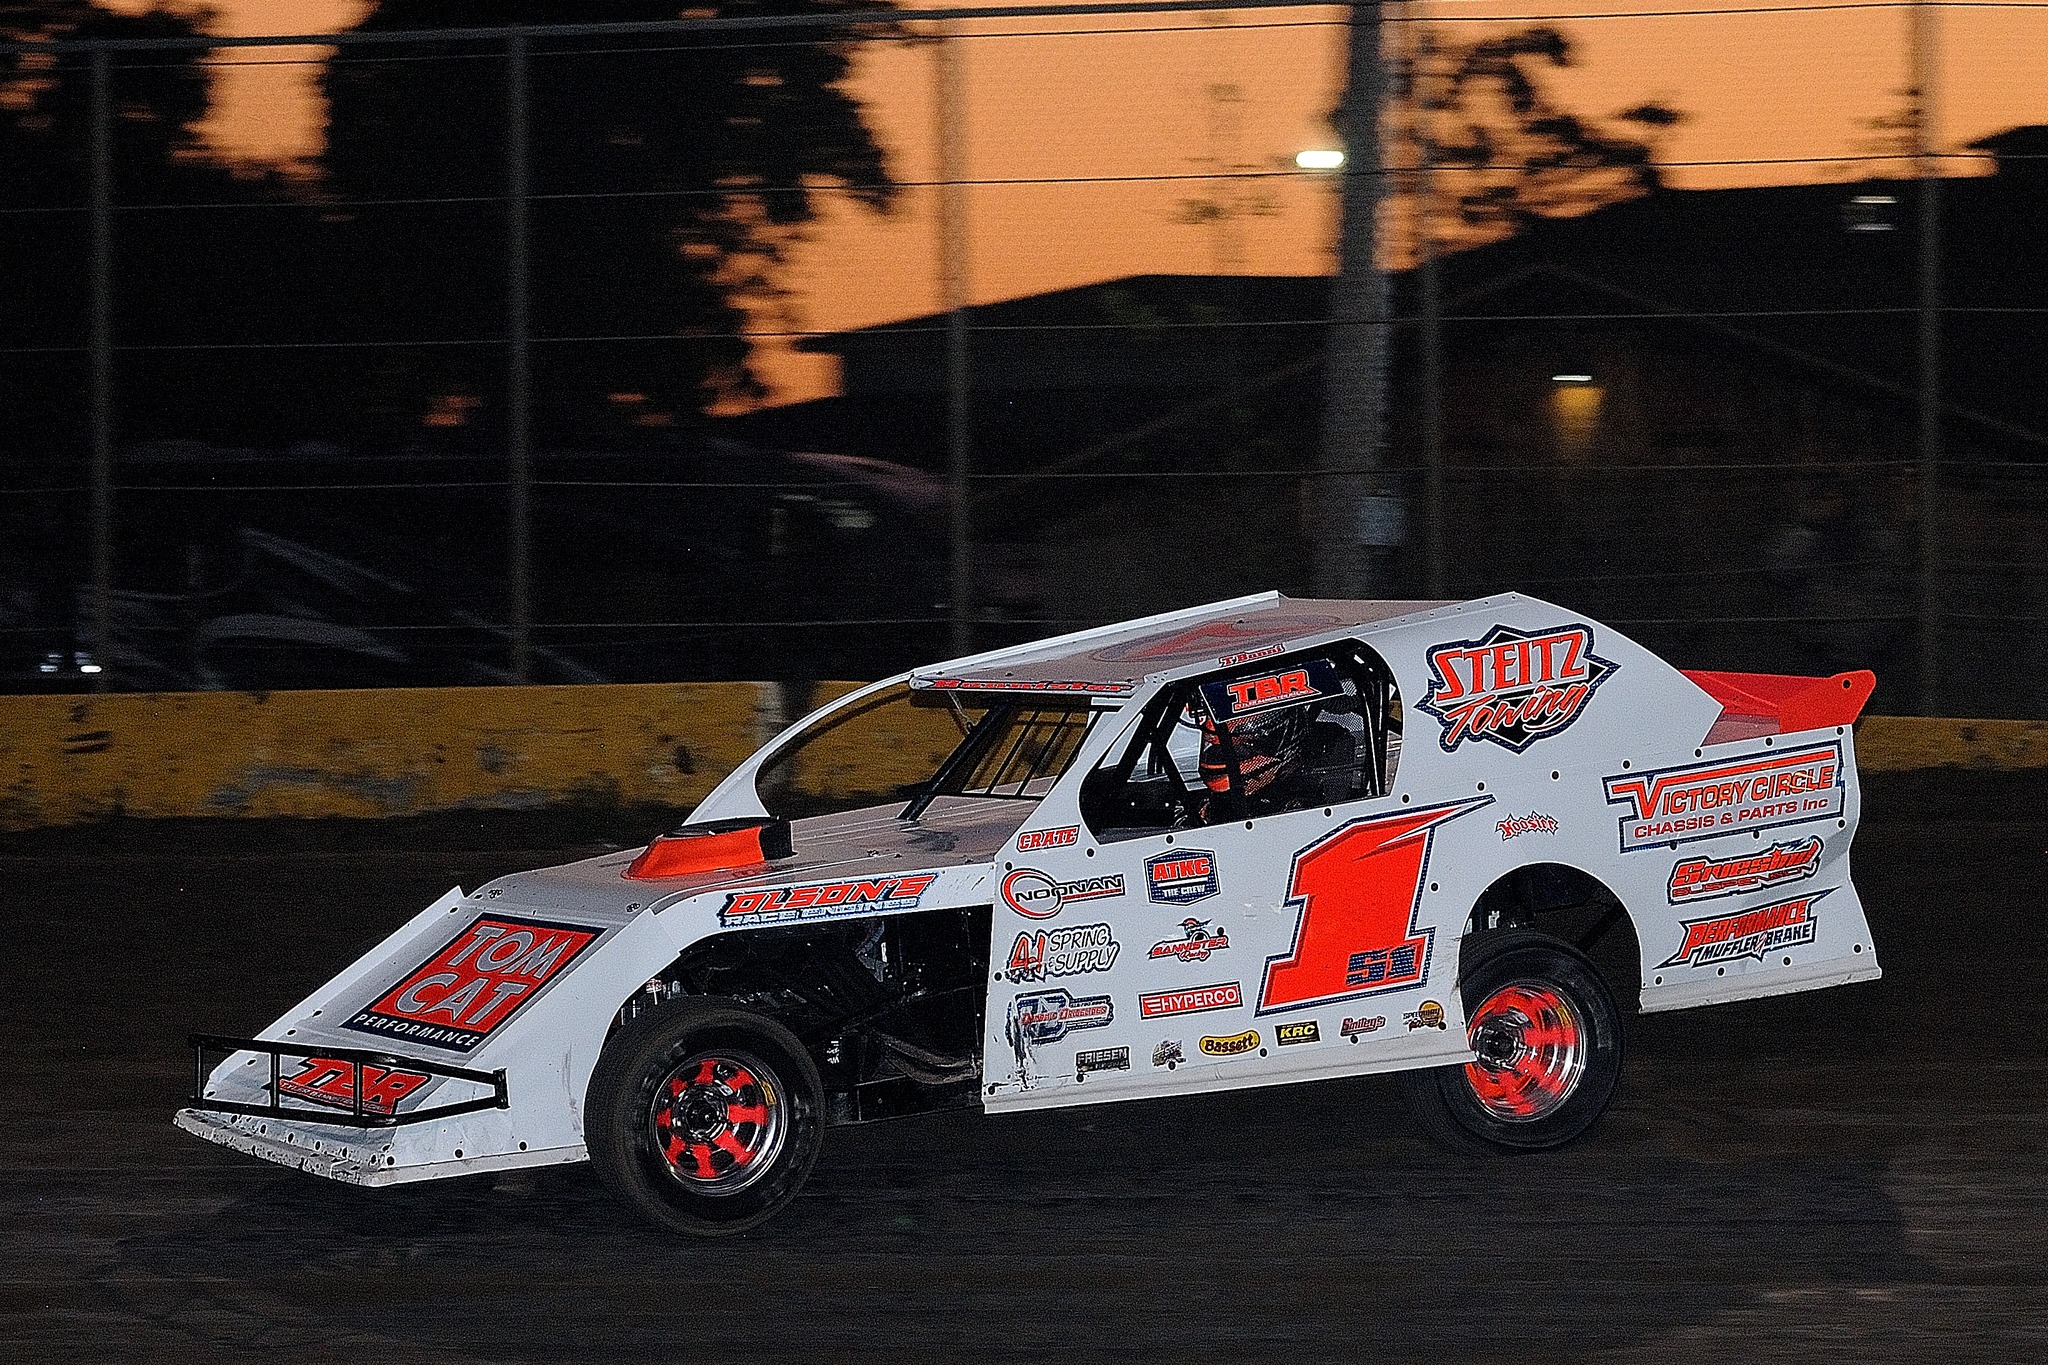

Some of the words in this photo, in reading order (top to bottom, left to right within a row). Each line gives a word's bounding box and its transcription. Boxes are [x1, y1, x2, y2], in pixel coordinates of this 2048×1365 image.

[1435, 632, 1584, 700] STEITZ
[1229, 671, 1314, 703] TBR
[1445, 685, 1588, 743] Towing
[1612, 766, 1751, 819] VICTORY
[1752, 765, 1834, 800] CIRCLE
[1498, 813, 1556, 838] Hoosier
[1634, 815, 1715, 838] CHASSIS
[1721, 812, 1733, 825] &
[1739, 802, 1797, 822] PARTS
[1803, 798, 1828, 810] Inc
[1019, 828, 1077, 849] CRATE
[1153, 857, 1211, 881] ATKC
[727, 875, 936, 915] OLSON'S
[1015, 879, 1122, 902] NOONAN
[1162, 888, 1179, 898] THE
[1181, 884, 1206, 895] CREW
[726, 911, 797, 925] RACE
[801, 898, 918, 918] ENGINES
[1255, 794, 1497, 1018] 1
[1050, 928, 1107, 952] SPRING
[1680, 899, 1808, 959] PERFORMANCE
[1700, 934, 1759, 960] MUFFLER
[1765, 923, 1813, 947] BRAKE
[448, 925, 572, 979] TOM
[1055, 946, 1116, 972] SUPPLY
[1153, 937, 1227, 957] BANNISTER
[397, 973, 529, 1025] CAT
[1162, 984, 1238, 1013] HYPERCO
[353, 1013, 480, 1047] PERFORMANCE
[1204, 1033, 1254, 1053] Bassett
[1280, 1024, 1316, 1039] KRC
[1077, 1047, 1128, 1065] FRIESEN
